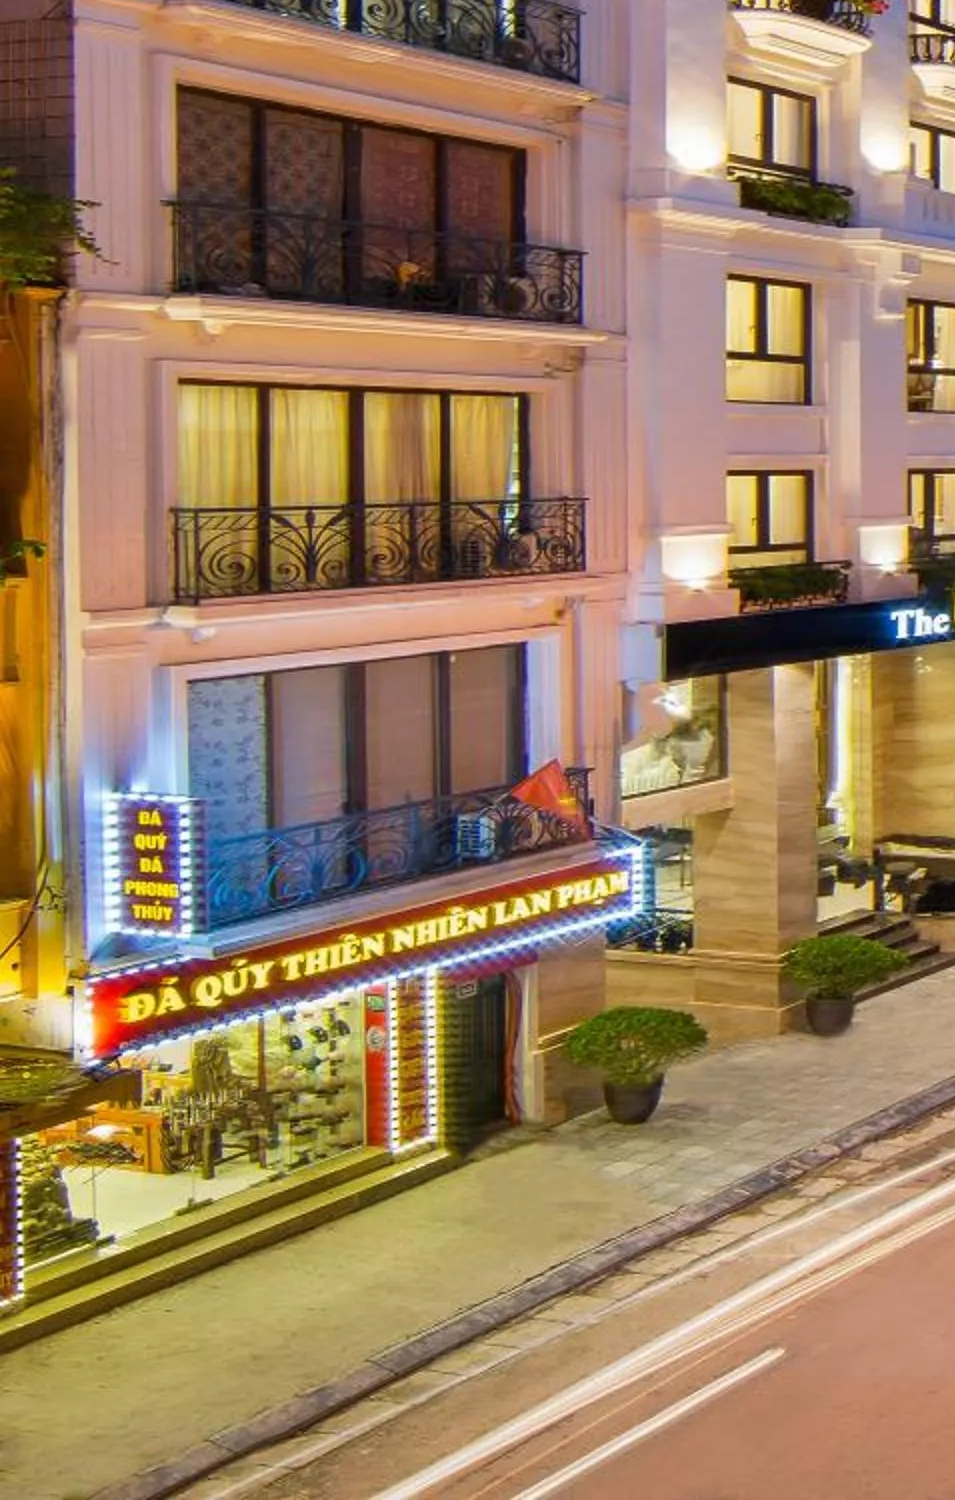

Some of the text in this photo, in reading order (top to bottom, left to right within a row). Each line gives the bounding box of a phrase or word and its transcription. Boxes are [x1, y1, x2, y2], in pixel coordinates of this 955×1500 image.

[890, 608, 951, 639] The
[123, 880, 180, 899] PHONG
[118, 976, 187, 1024] ĐÁ
[281, 932, 387, 982] THIÊN
[390, 904, 490, 953] NHIÊN
[493, 890, 554, 927] LAN
[556, 870, 630, 907] PHẠM
